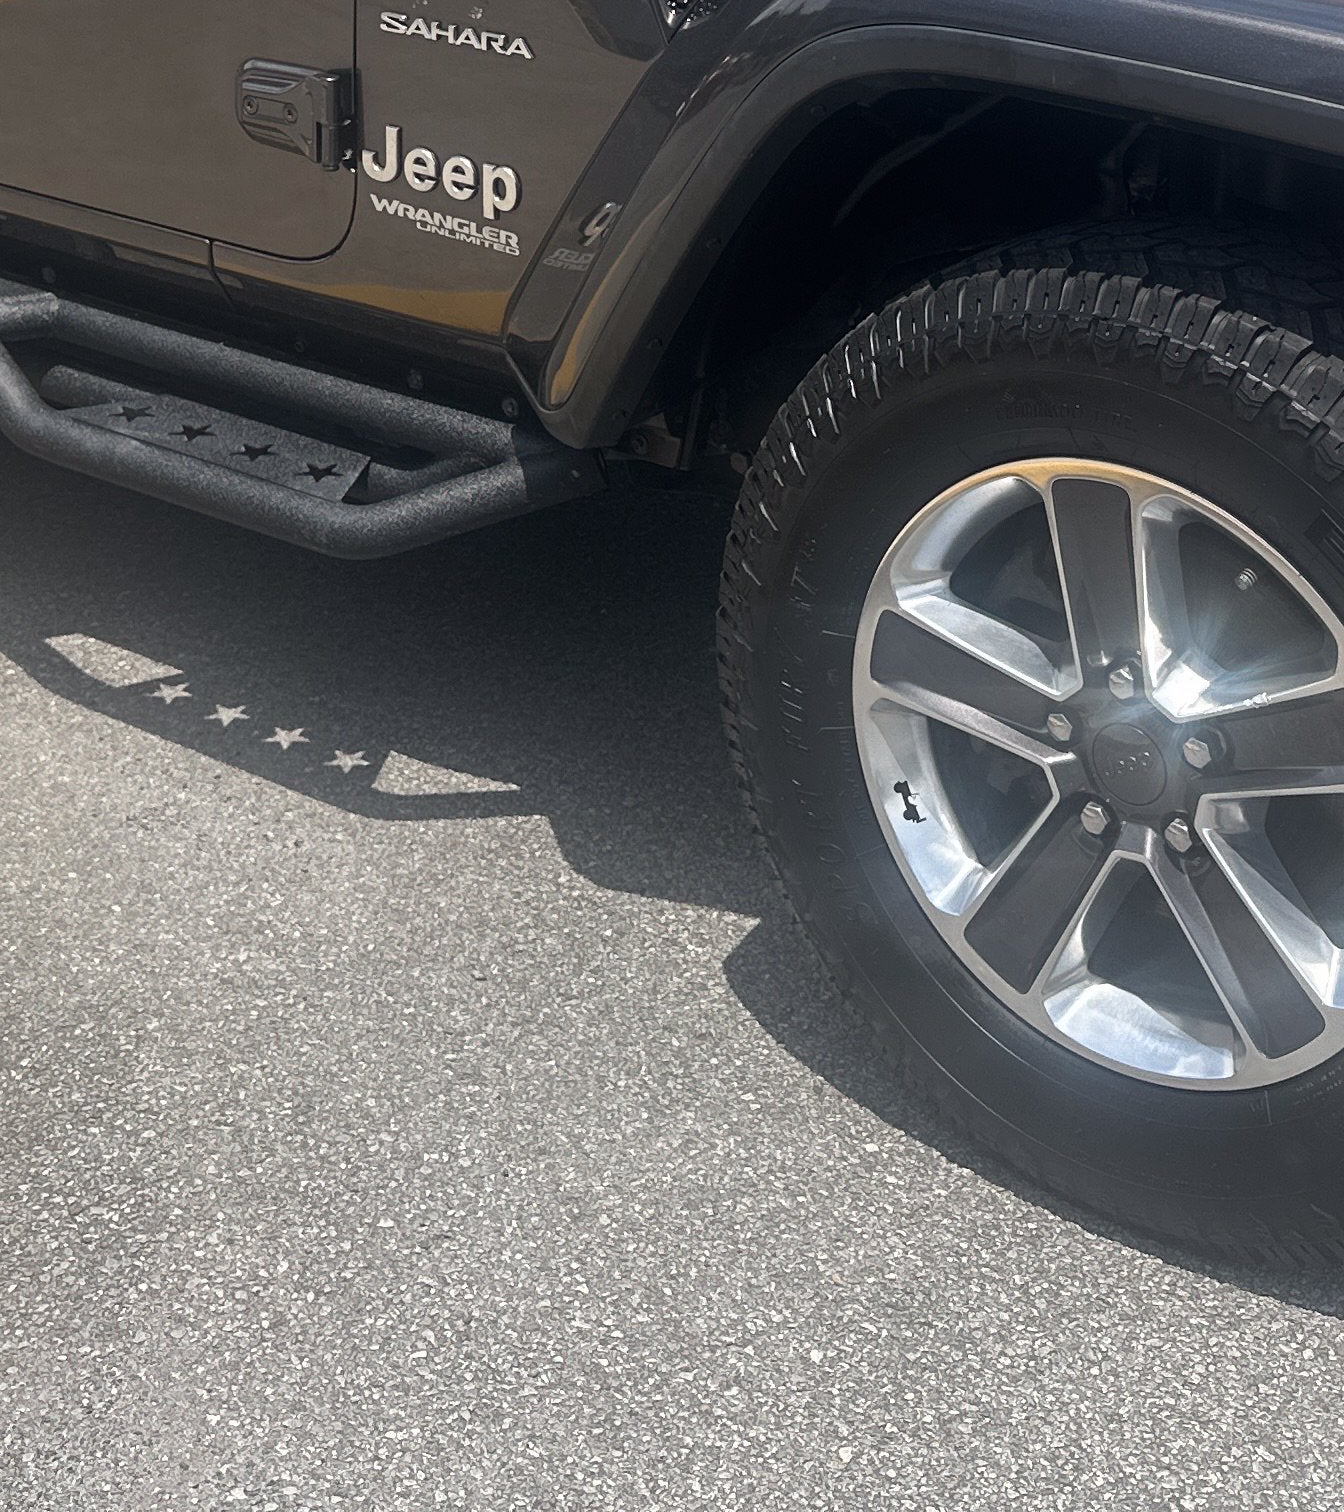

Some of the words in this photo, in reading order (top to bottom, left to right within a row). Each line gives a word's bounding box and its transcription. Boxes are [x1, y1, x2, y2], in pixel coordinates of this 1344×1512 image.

[379, 10, 534, 60] SAHARA
[361, 124, 522, 221] Jeep
[369, 193, 521, 250] WRANGLER
[415, 221, 521, 257] UNLIMITED
